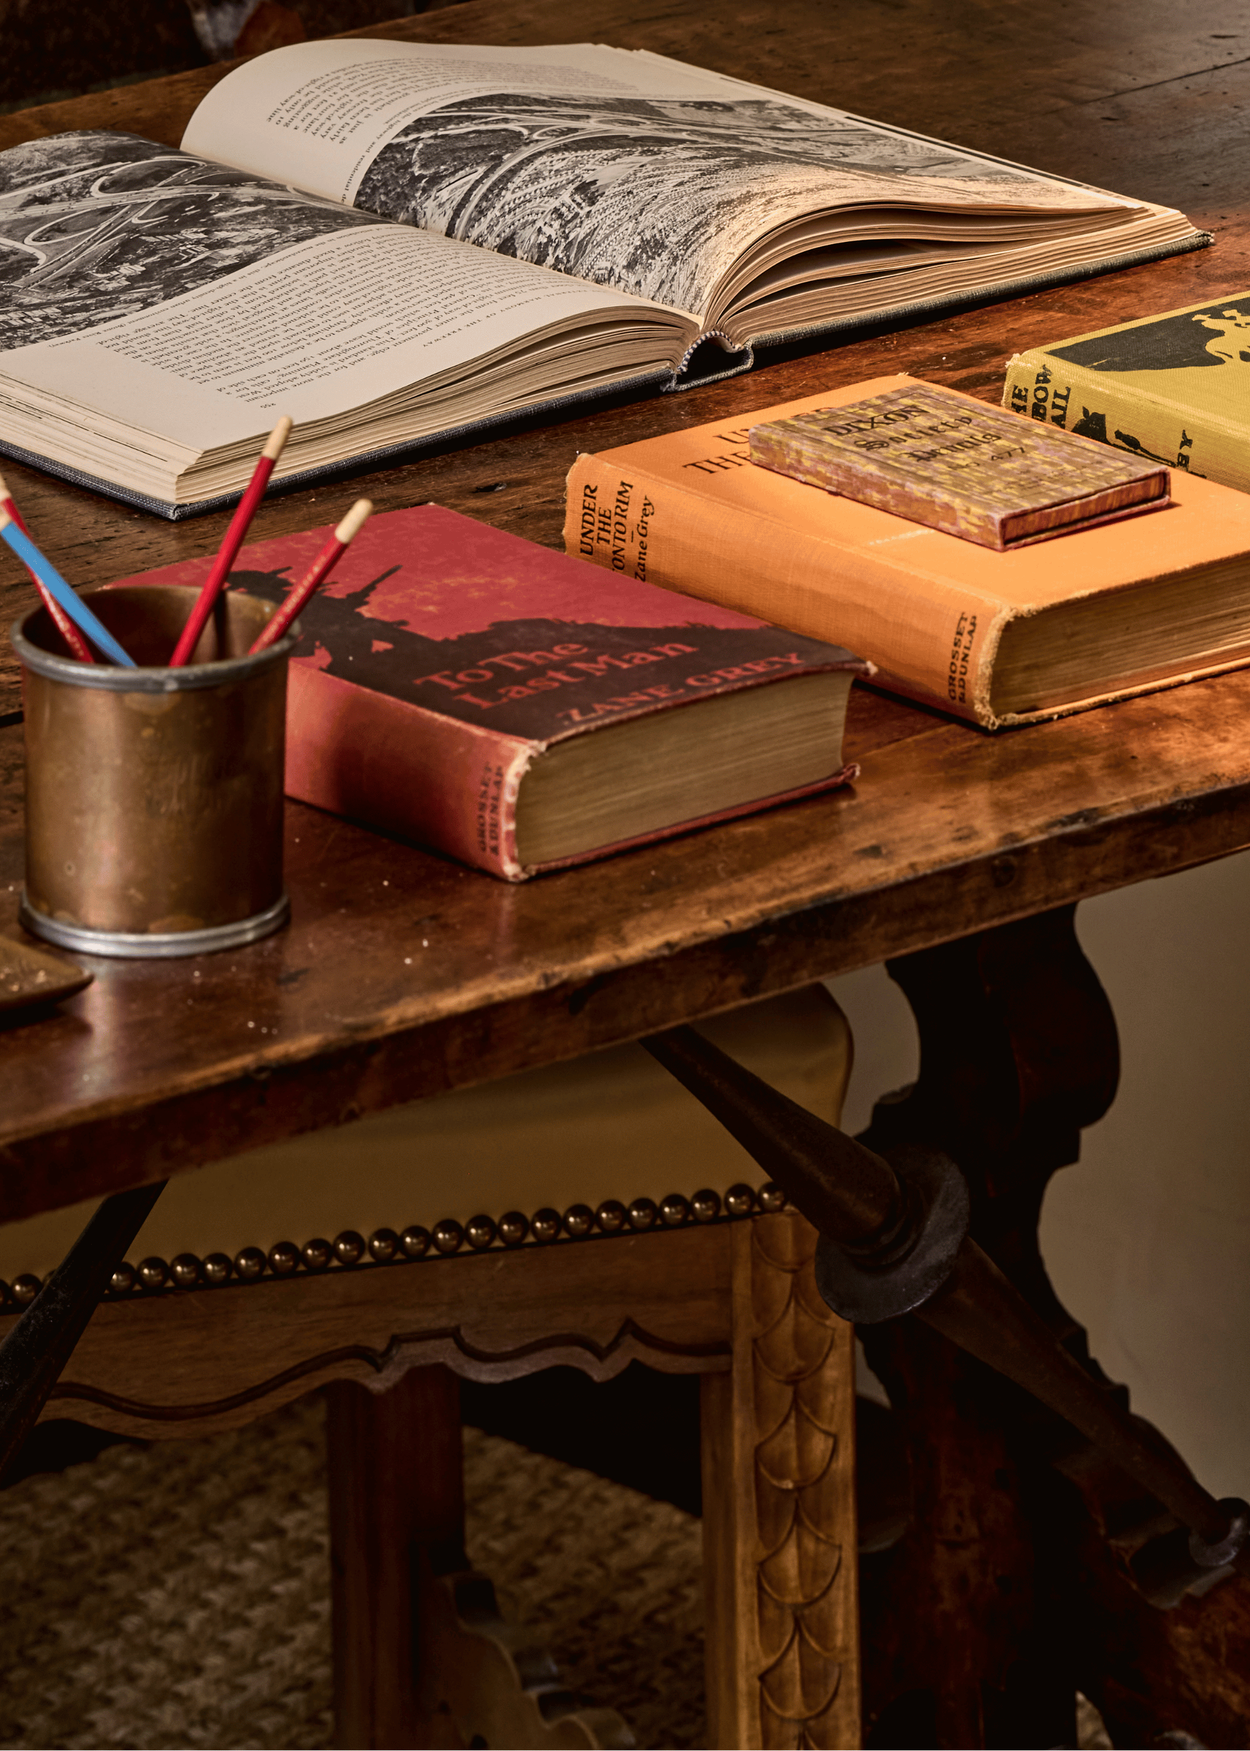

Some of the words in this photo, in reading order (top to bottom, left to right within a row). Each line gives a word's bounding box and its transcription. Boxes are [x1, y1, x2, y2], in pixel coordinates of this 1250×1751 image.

[280, 77, 324, 106] right-of-way
[283, 95, 320, 128] suggesting
[285, 99, 301, 113] only
[313, 100, 328, 110] feet
[338, 99, 368, 120] freeway
[350, 107, 370, 120] been
[267, 108, 282, 122] line
[301, 113, 312, 122] for
[303, 104, 335, 133] four-lane
[311, 96, 353, 136] right-of-way
[320, 124, 336, 138] vary
[330, 122, 350, 141] fairly
[349, 121, 363, 133] just
[377, 116, 400, 139] highway
[366, 142, 375, 152] and
[345, 155, 365, 190] residential
[369, 306, 393, 317] width
[396, 310, 439, 329] Principles
[336, 318, 366, 332] appears
[436, 317, 457, 327] outer
[376, 337, 396, 346] This
[393, 327, 432, 346] pavement
[268, 345, 305, 361] desirable
[318, 345, 342, 355] about
[324, 336, 381, 361] Thoroughfare
[338, 346, 374, 362] standard
[222, 361, 265, 376] minimum
[283, 362, 299, 370] feet
[300, 366, 328, 377] widely
[292, 378, 314, 387] more
[245, 387, 290, 402] important
[1011, 384, 1029, 416] HE
[822, 405, 930, 436] DIXON
[854, 416, 972, 451] Society
[991, 447, 1026, 461] 477
[1176, 430, 1193, 471] BY
[615, 480, 633, 520] RIM
[580, 484, 598, 556] UNDER
[597, 507, 612, 544] THE
[637, 495, 654, 538] Grey
[612, 521, 626, 571] ONTO
[635, 540, 648, 582] Zane
[948, 612, 968, 700] GROSSET
[413, 666, 494, 693] To
[477, 642, 588, 673] The
[453, 666, 585, 710] Last
[571, 642, 699, 677] Man
[556, 683, 685, 723] ZANE
[685, 652, 804, 687] GREY
